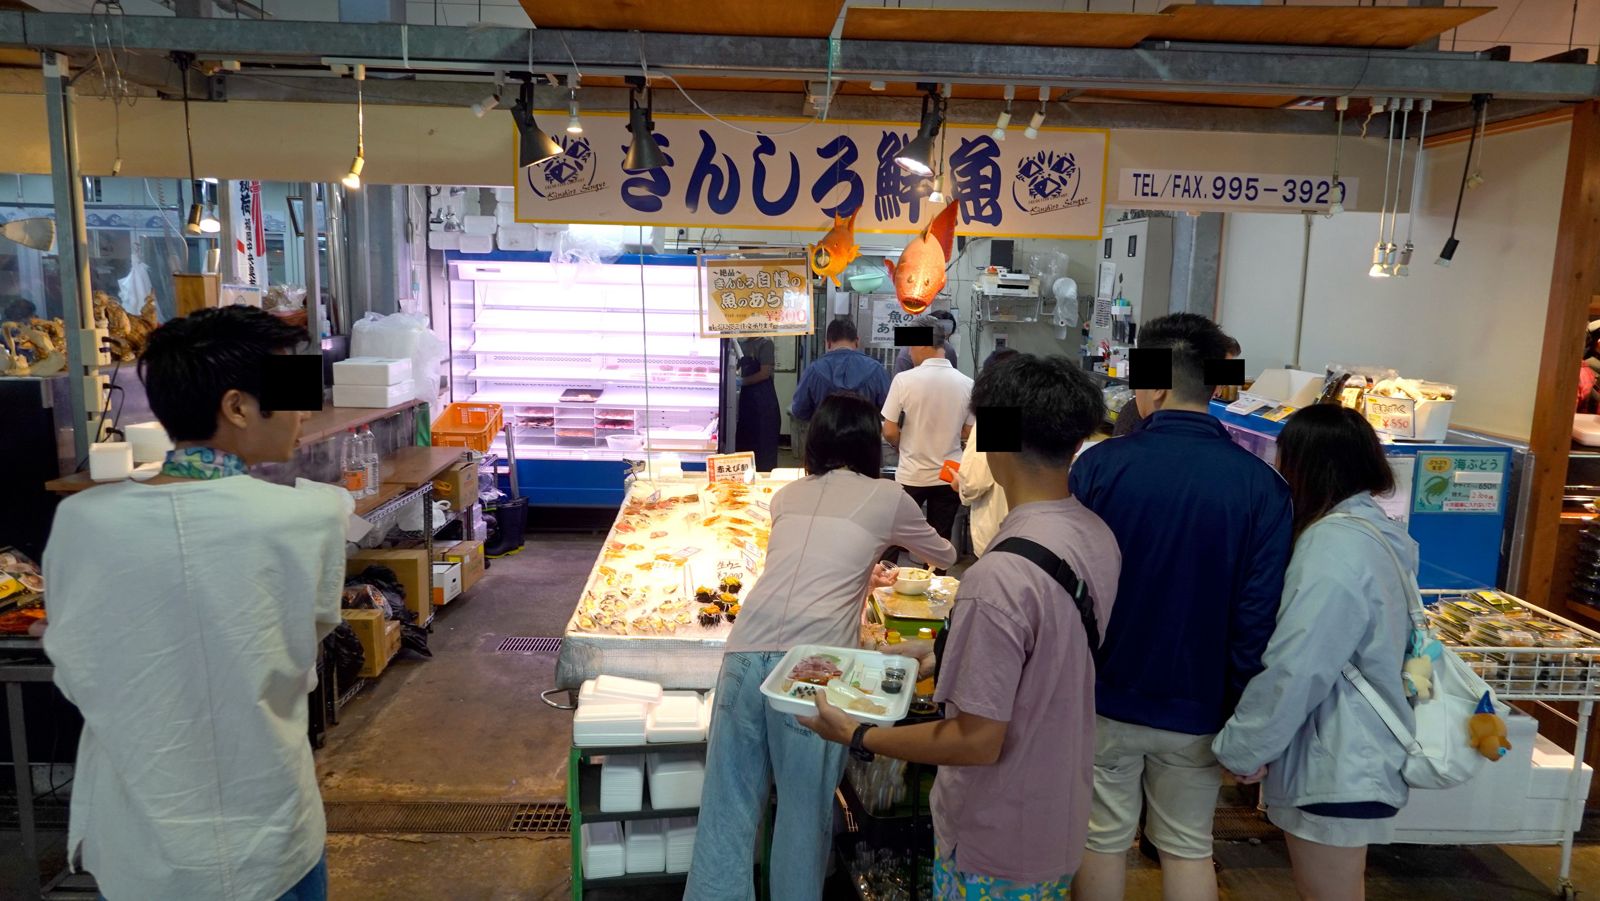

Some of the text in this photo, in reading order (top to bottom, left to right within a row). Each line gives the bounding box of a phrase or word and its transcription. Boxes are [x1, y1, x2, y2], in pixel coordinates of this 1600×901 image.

[621, 129, 1003, 227] きんしろ鮮魚
[1454, 458, 1498, 471] 海ぶどう
